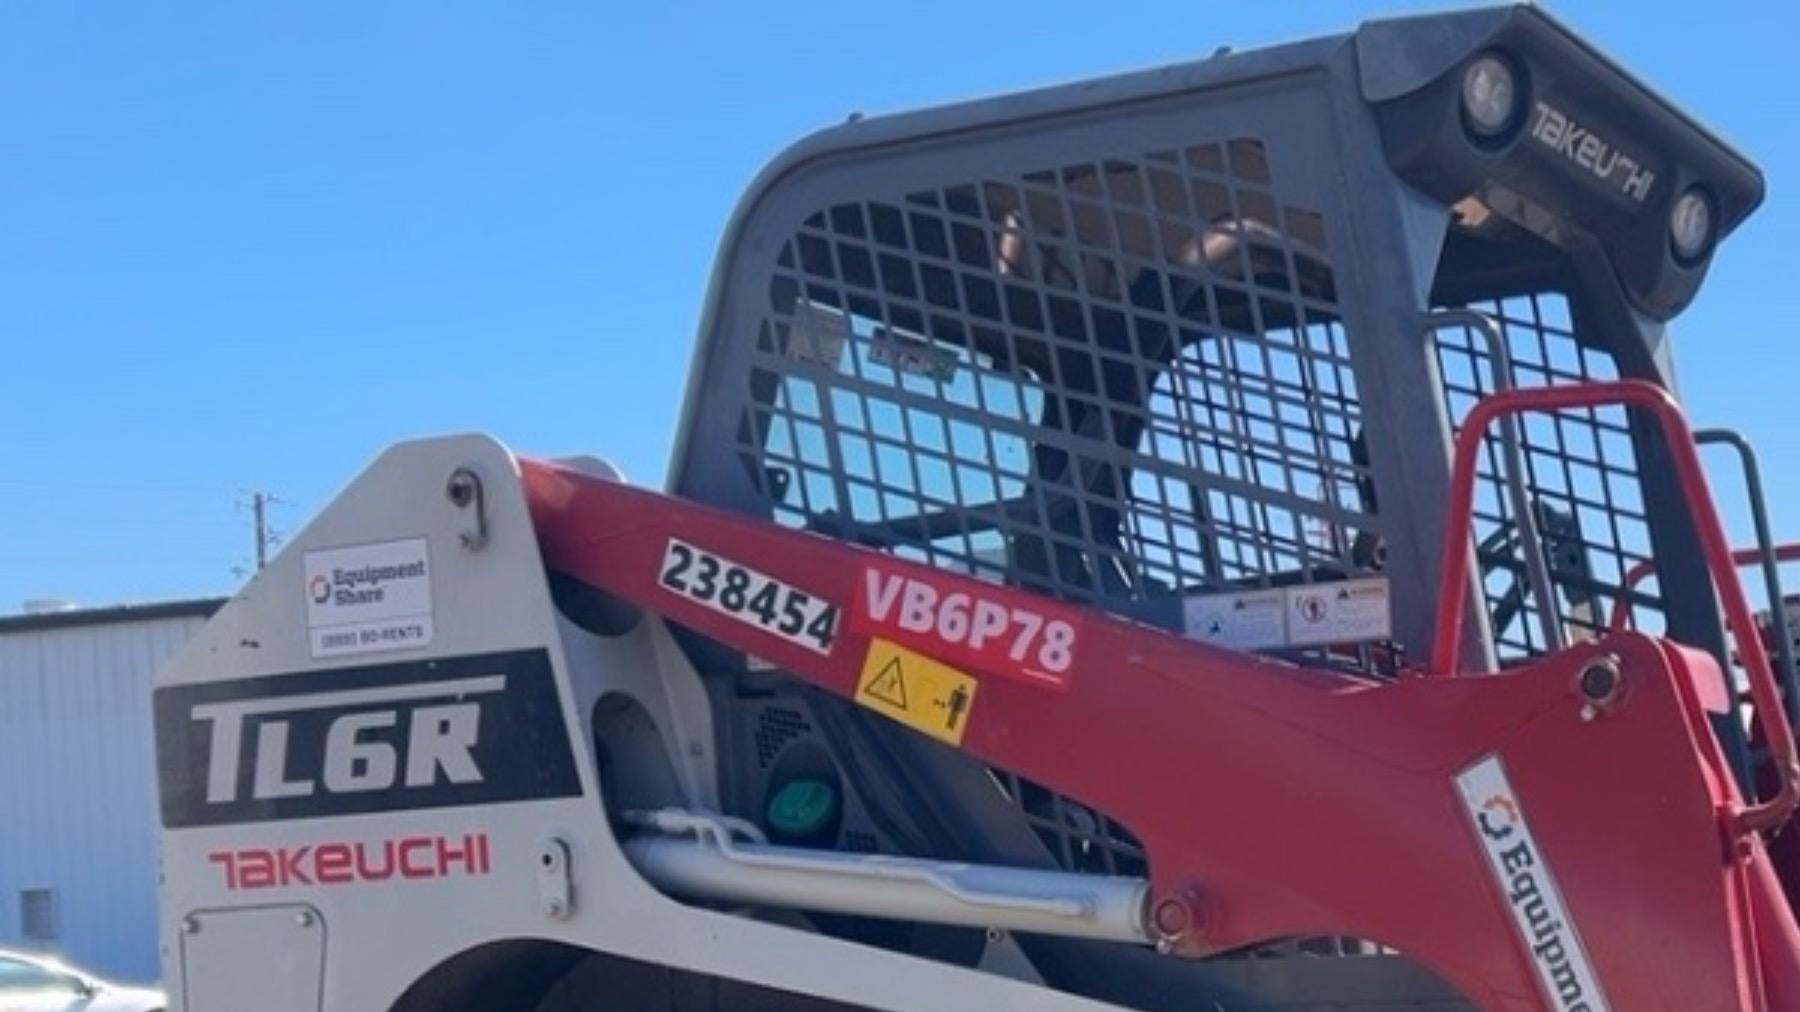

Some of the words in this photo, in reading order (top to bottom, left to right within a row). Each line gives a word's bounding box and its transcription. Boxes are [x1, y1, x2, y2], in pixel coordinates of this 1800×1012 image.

[333, 561, 424, 588] Equipment
[335, 588, 385, 606] Share
[664, 543, 840, 650] 238454
[864, 569, 1077, 674] VB6P78
[191, 675, 506, 804] TL6R
[209, 834, 490, 890] TAKEUCHI
